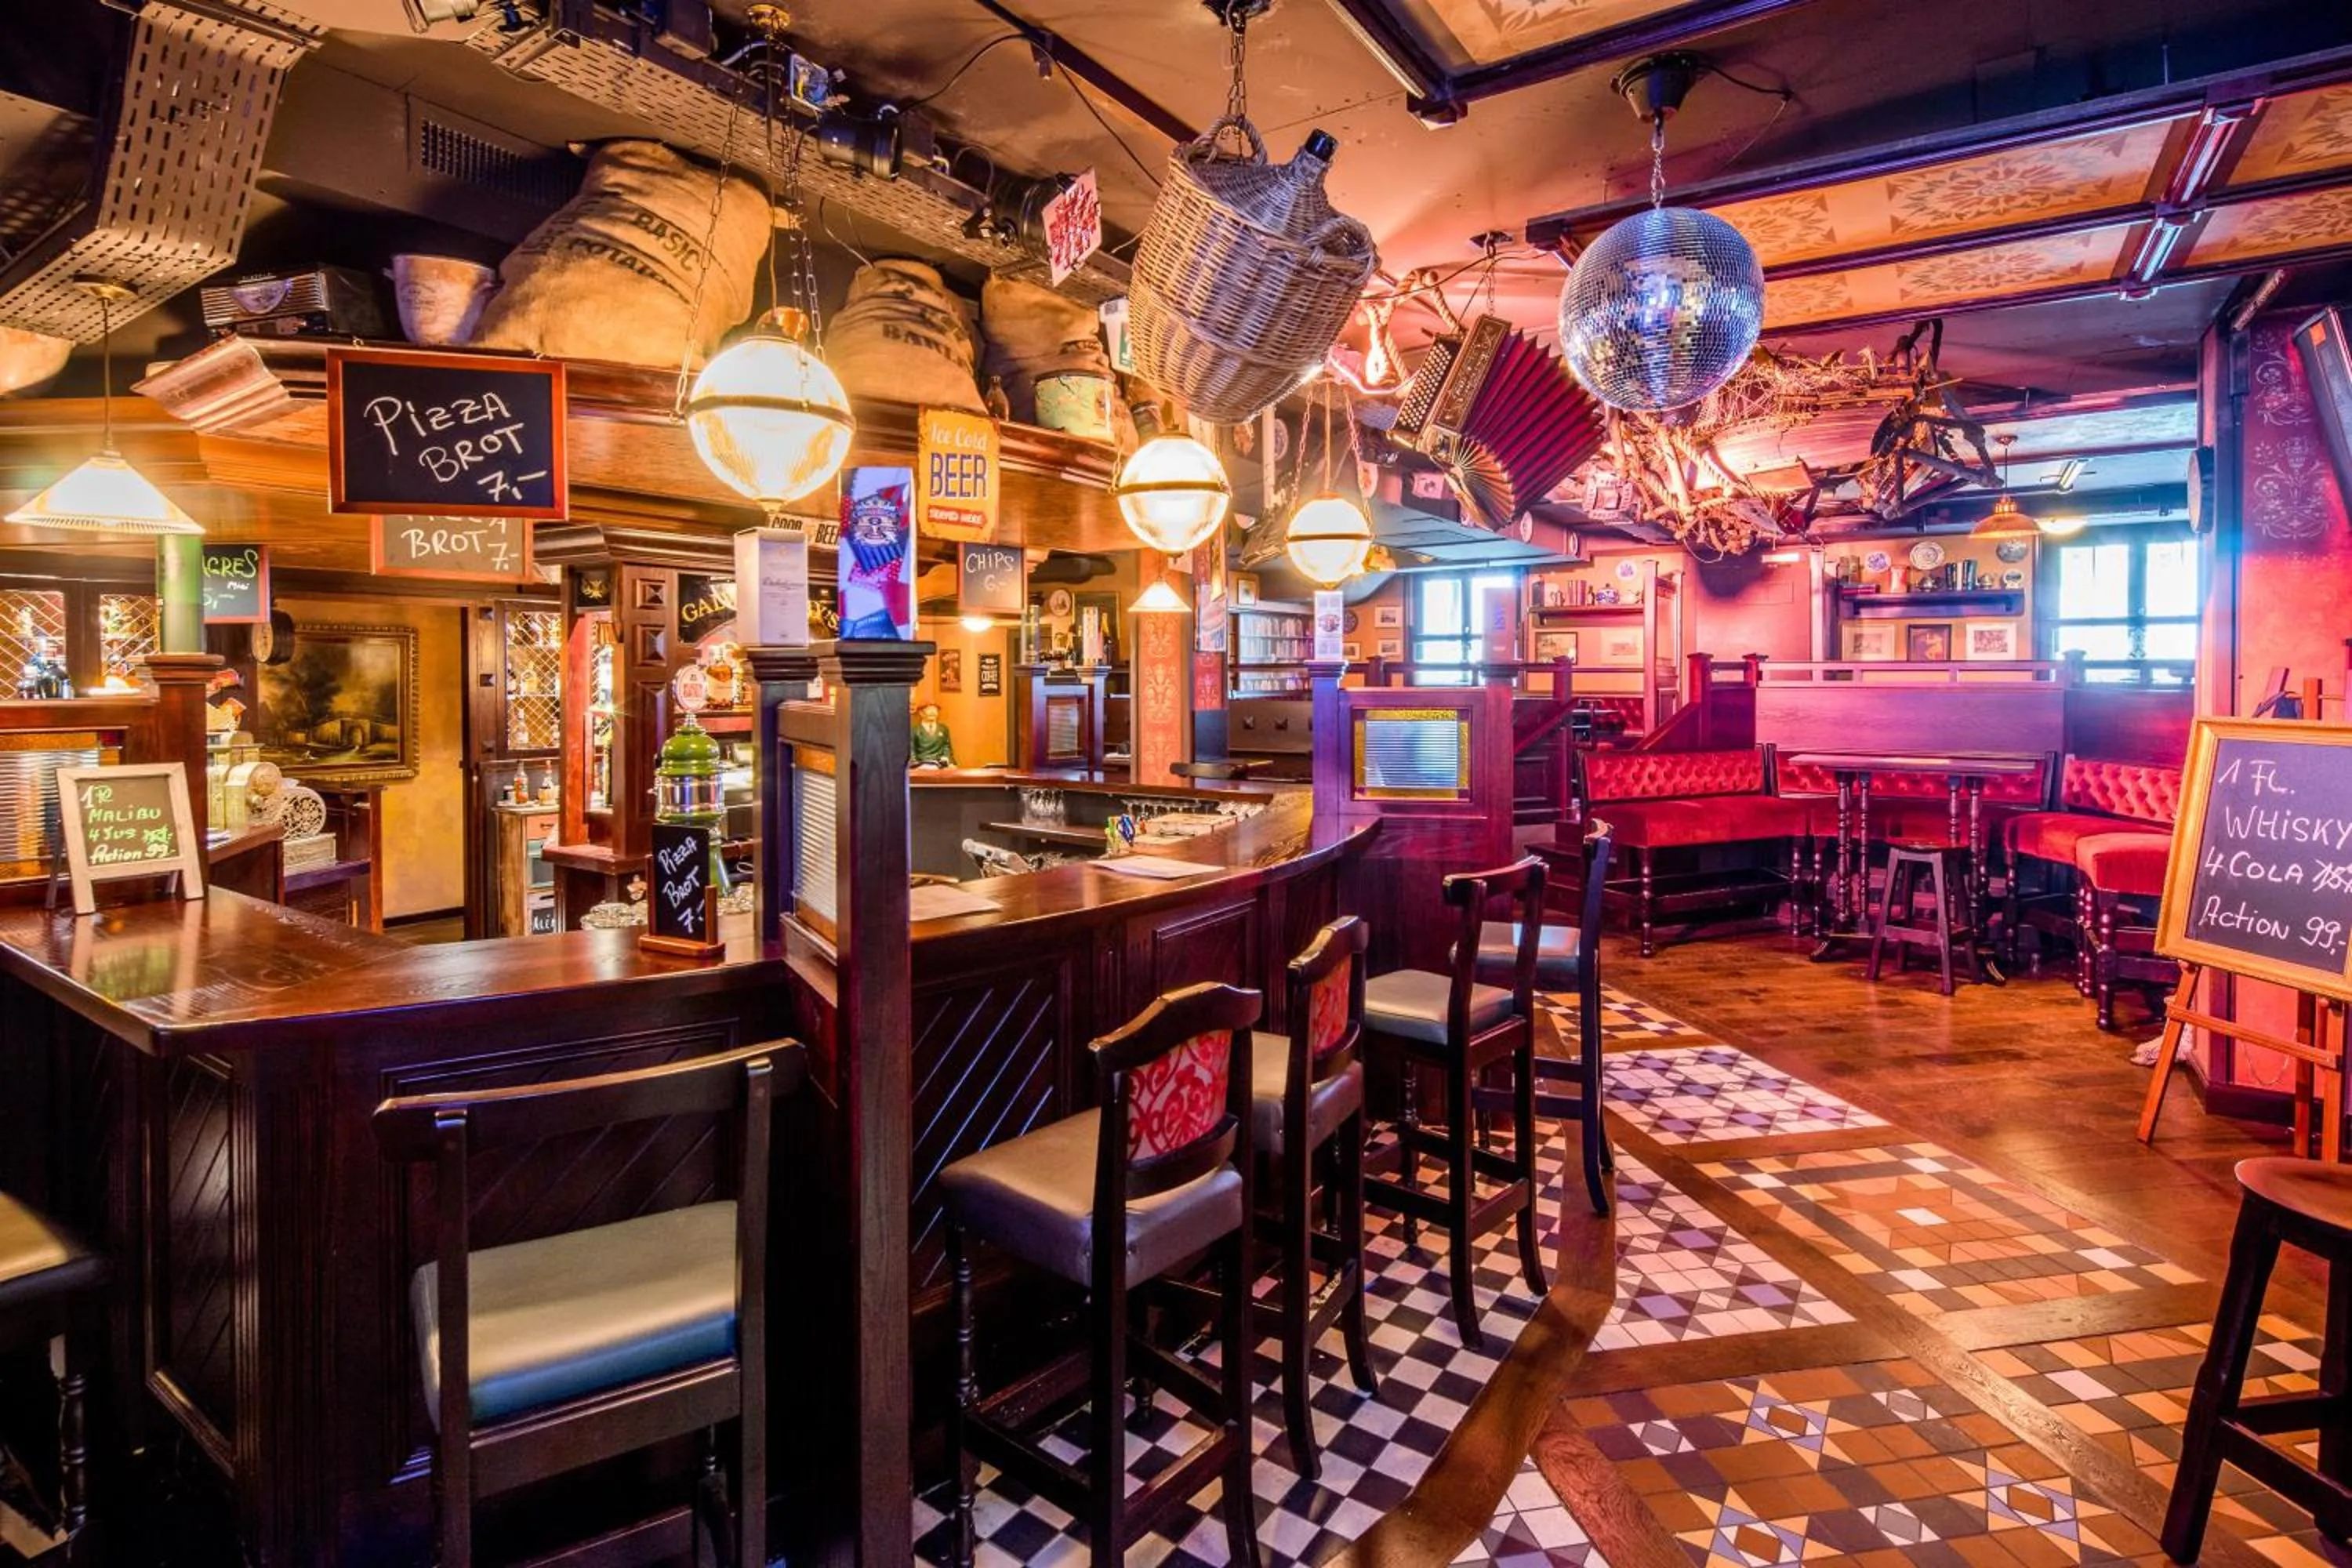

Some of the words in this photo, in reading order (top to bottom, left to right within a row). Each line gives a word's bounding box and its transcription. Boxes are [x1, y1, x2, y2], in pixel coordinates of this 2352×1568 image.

[628, 210, 700, 272] BASIC
[418, 423, 524, 483] BROT
[930, 424, 952, 444] Ice
[956, 427, 989, 452] Cold
[930, 451, 988, 499] BEER
[401, 529, 488, 559] BROT
[815, 523, 840, 546] BEE
[2218, 758, 2241, 784] 1
[88, 827, 100, 842] 4
[2205, 846, 2224, 877] 4
